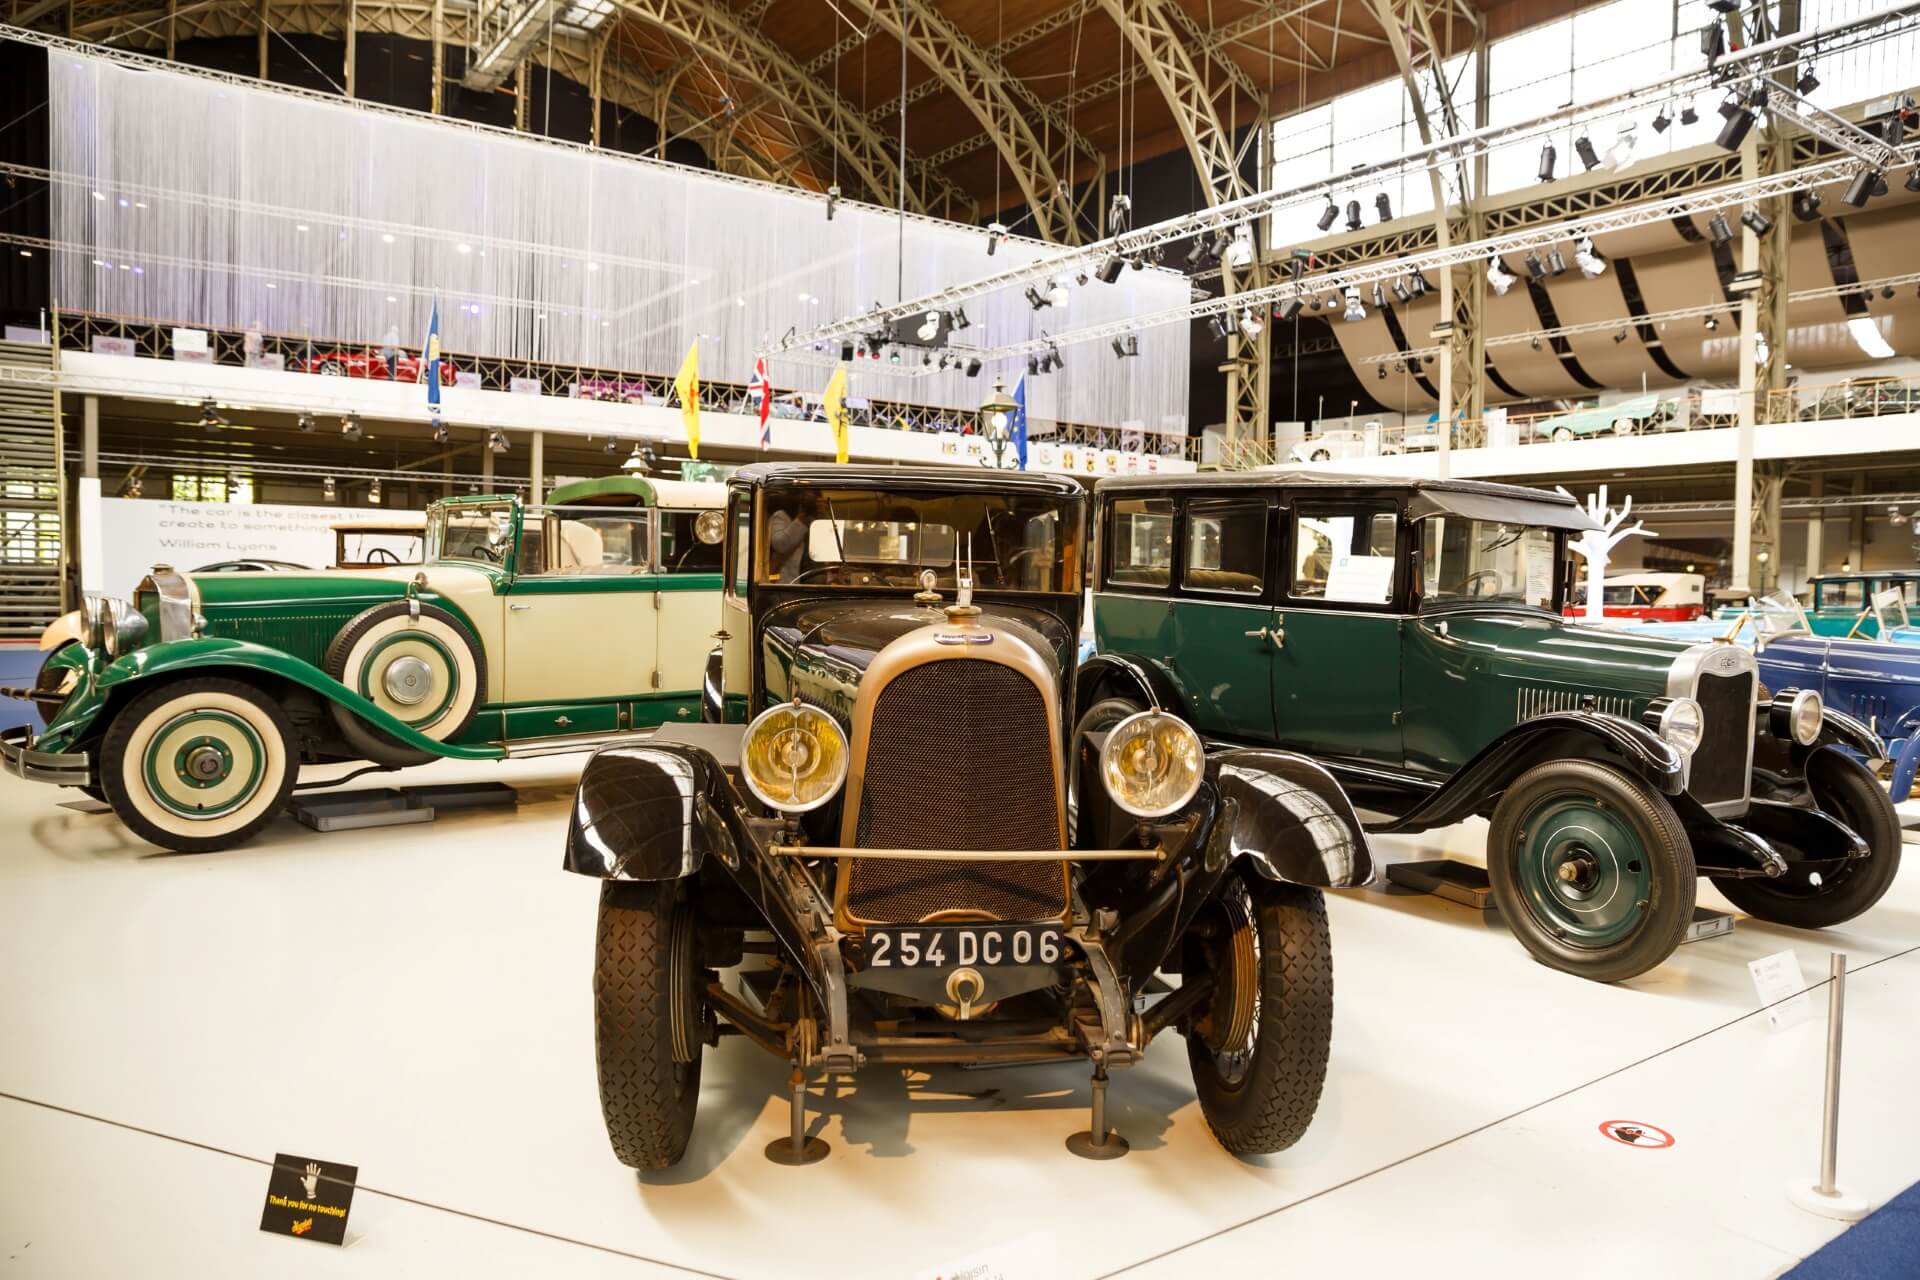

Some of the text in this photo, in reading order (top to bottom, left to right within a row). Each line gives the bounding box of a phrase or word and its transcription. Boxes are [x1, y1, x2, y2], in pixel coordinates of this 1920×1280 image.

[206, 508, 232, 517] car
[238, 507, 251, 517] is
[256, 508, 283, 518] the
[287, 510, 343, 520] closest
[159, 519, 215, 529] create
[220, 520, 239, 530] to
[159, 538, 278, 552] William Lyons
[871, 930, 1059, 967] 254 DC 06
[269, 1195, 287, 1206] Thank
[288, 1200, 298, 1209] you
[299, 1200, 308, 1210] for
[317, 1205, 347, 1218] touching!
